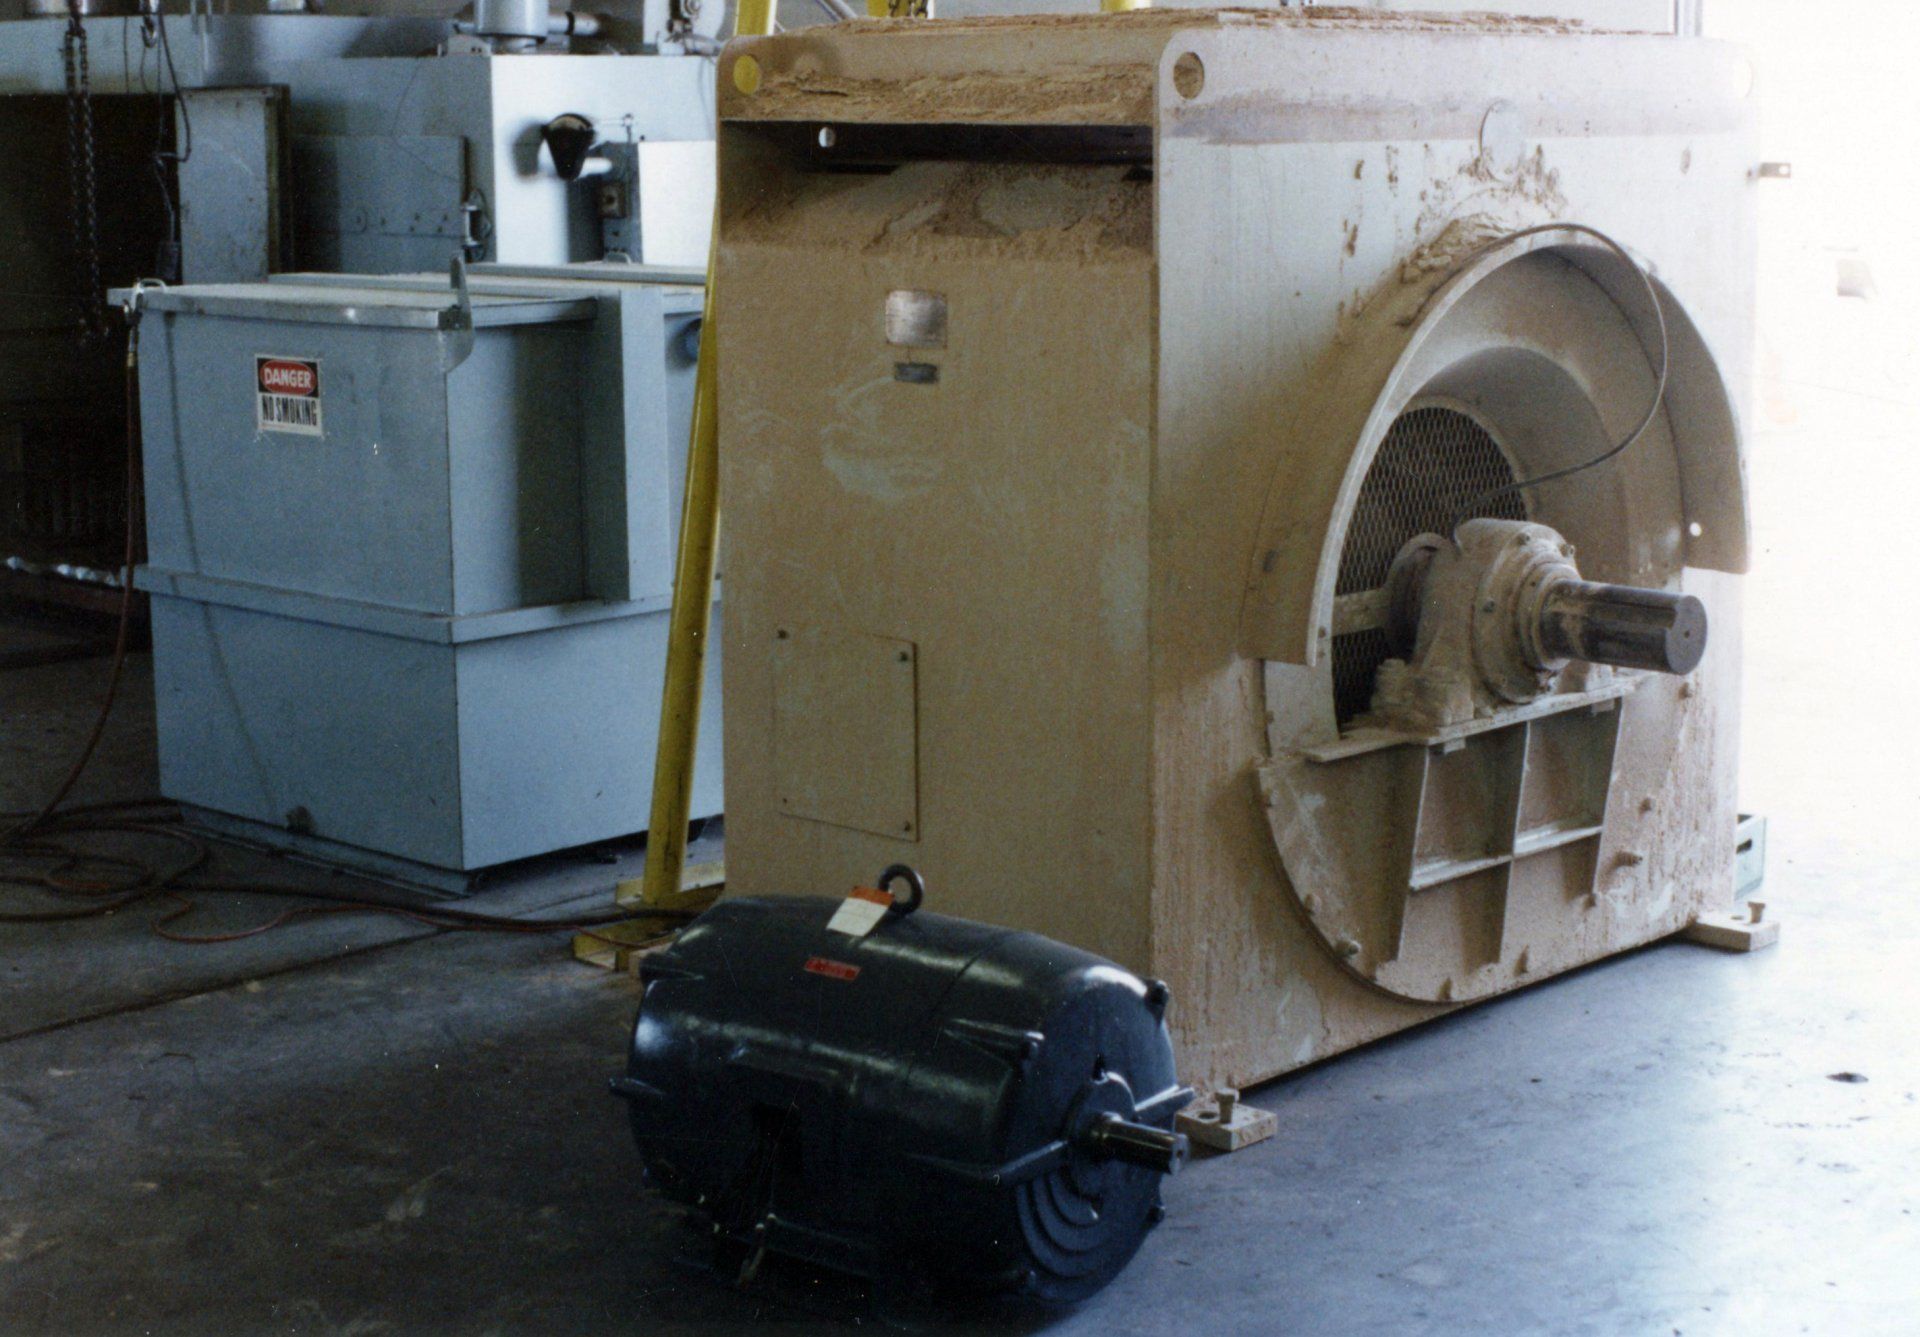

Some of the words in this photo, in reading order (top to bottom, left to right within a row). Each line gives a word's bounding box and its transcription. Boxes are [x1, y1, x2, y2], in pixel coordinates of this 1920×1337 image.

[263, 367, 312, 388] DANGER
[262, 395, 274, 421] NO
[276, 397, 317, 426] SMOKING
